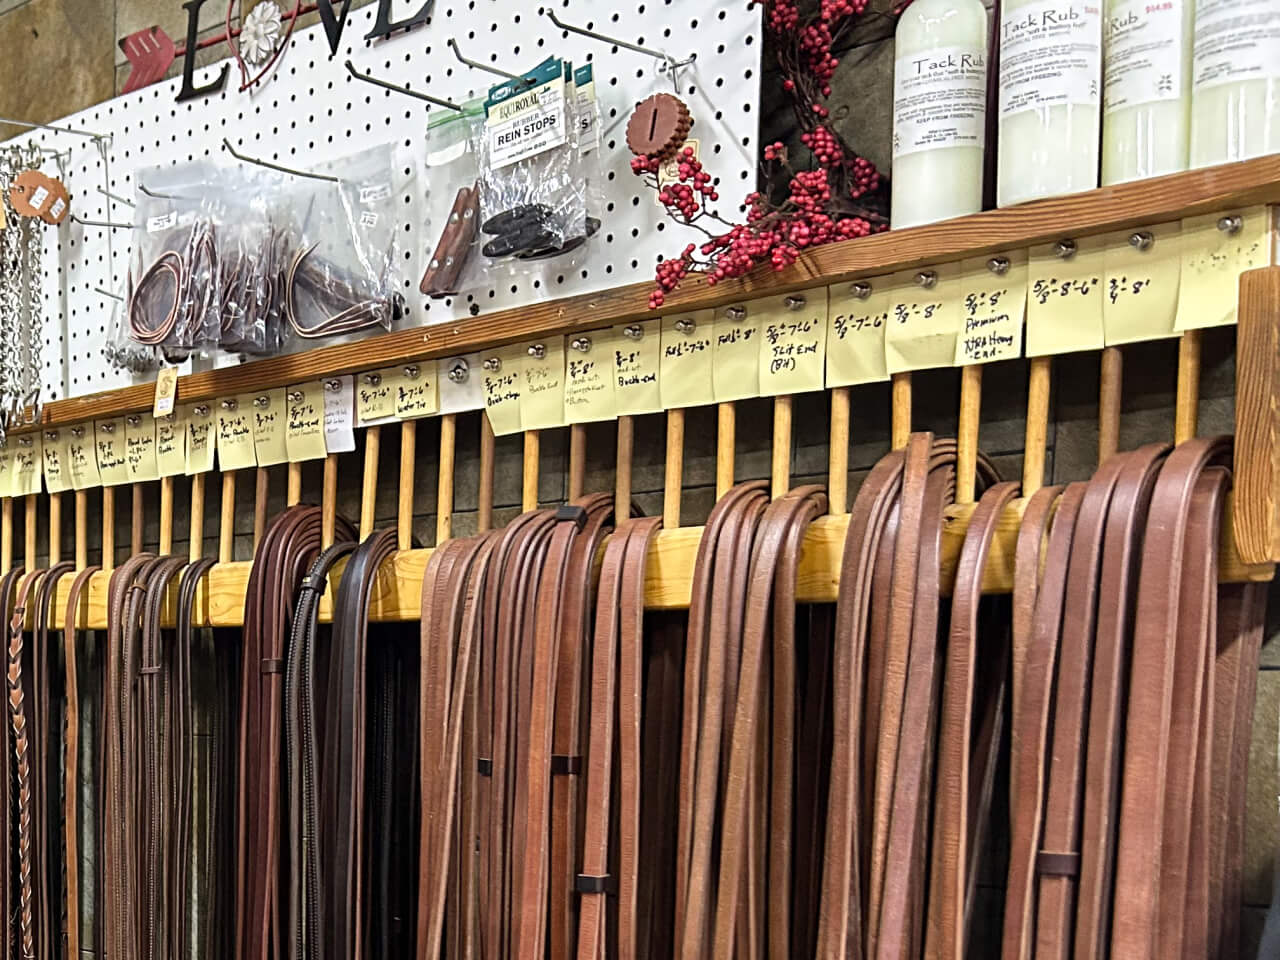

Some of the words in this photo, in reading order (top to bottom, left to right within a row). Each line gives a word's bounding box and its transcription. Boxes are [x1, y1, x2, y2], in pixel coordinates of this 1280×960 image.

[1003, 13, 1038, 38] Tack
[1042, 6, 1080, 26] Rub
[1111, 11, 1139, 31] Rub
[912, 54, 957, 74] Tack
[961, 54, 985, 68] Rub
[497, 129, 521, 146] REIN
[524, 114, 557, 136] STOPS
[965, 313, 1010, 334] Premium
[796, 341, 819, 355] End
